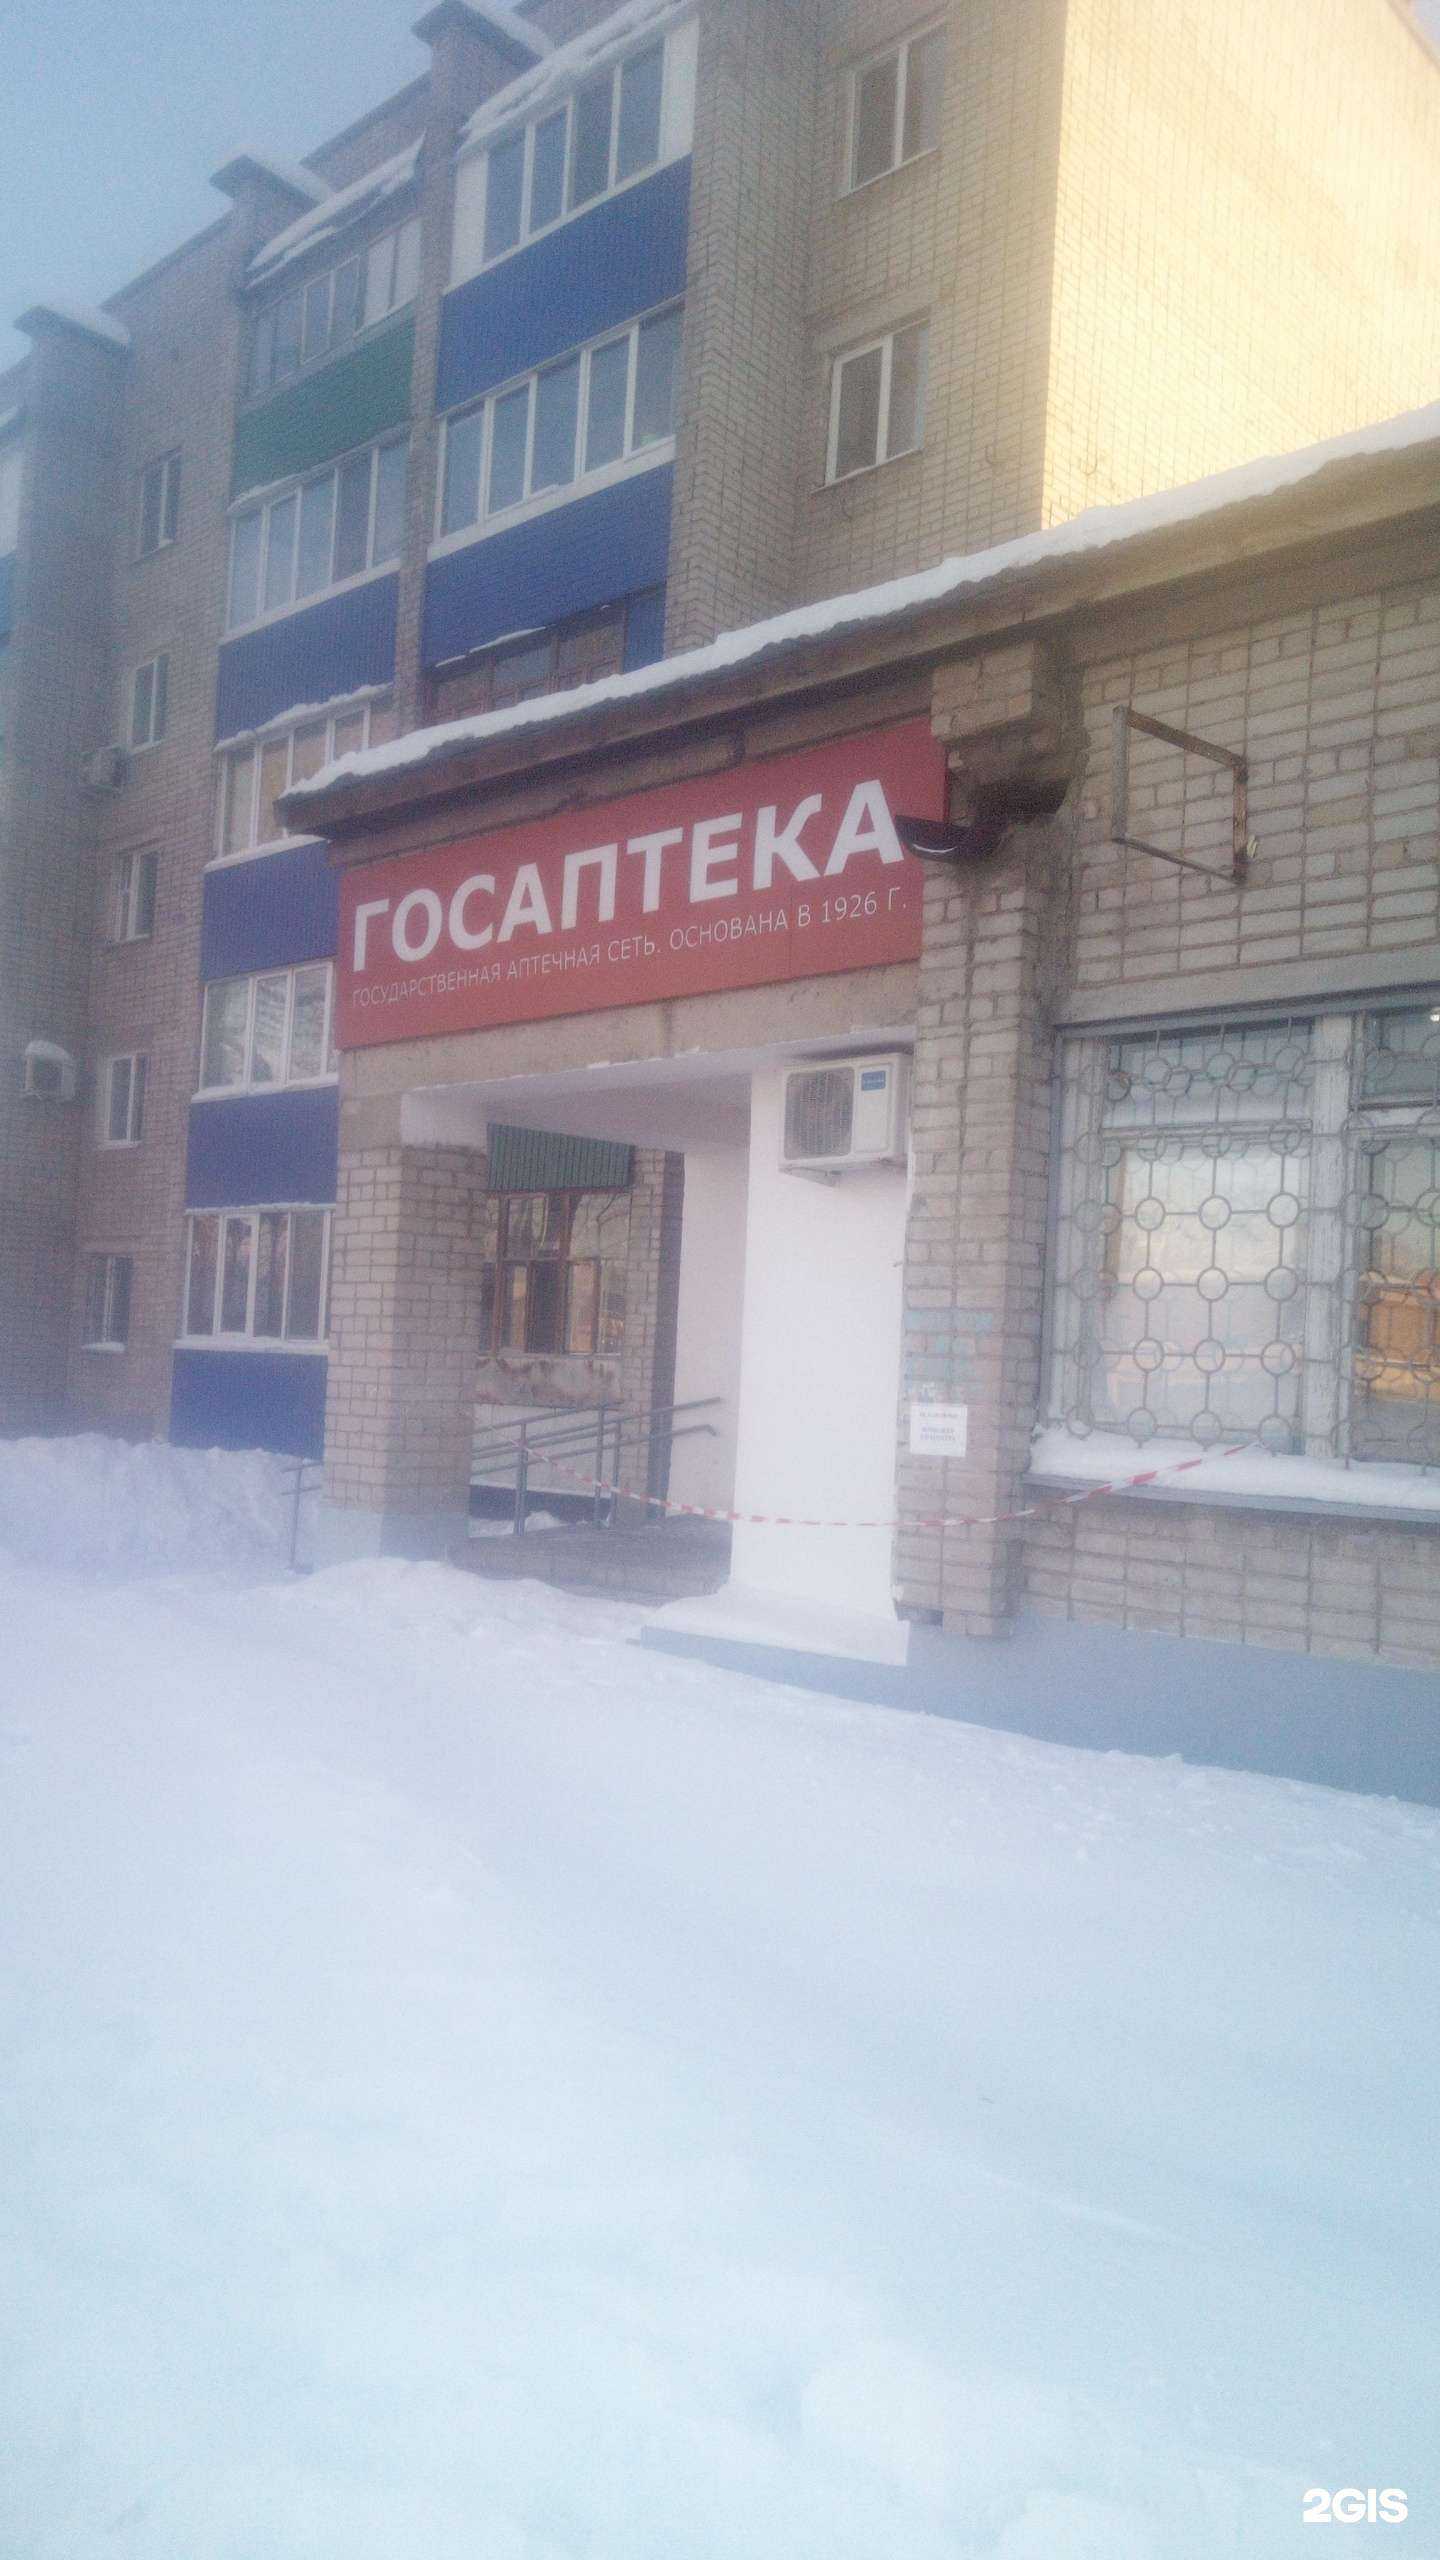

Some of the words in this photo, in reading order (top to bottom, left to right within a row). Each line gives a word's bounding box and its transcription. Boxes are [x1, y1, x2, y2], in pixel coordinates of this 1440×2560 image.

[353, 779, 904, 971] ГОСАПТЕКА
[353, 962, 501, 1007] ГОСУДАРСТВЕННАЯ
[507, 944, 600, 981] АПТЕЧНАЯ
[608, 934, 661, 961] СЕТЬ.
[669, 910, 788, 951] ОСНОВАНА
[797, 904, 812, 928] В
[821, 892, 878, 924] 1926
[886, 887, 907, 912] Г.
